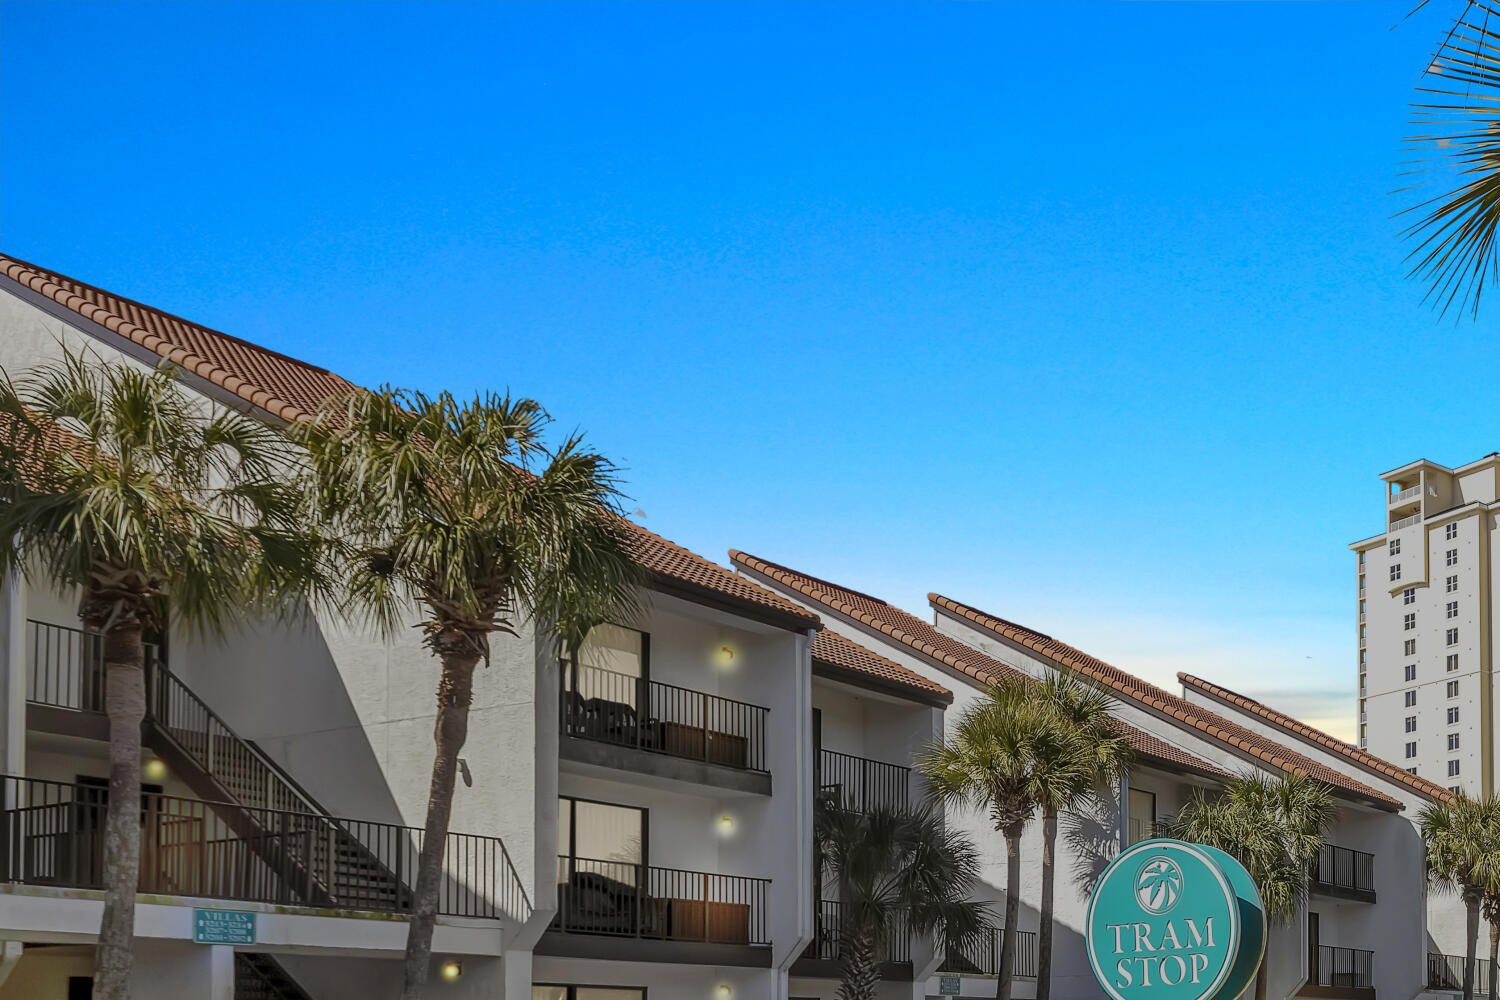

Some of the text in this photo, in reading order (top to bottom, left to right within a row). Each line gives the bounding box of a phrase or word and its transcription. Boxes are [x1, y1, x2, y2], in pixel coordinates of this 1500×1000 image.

[205, 912, 248, 920] VILLAS
[1106, 917, 1217, 954] TRAM
[1116, 953, 1209, 989] STOP
